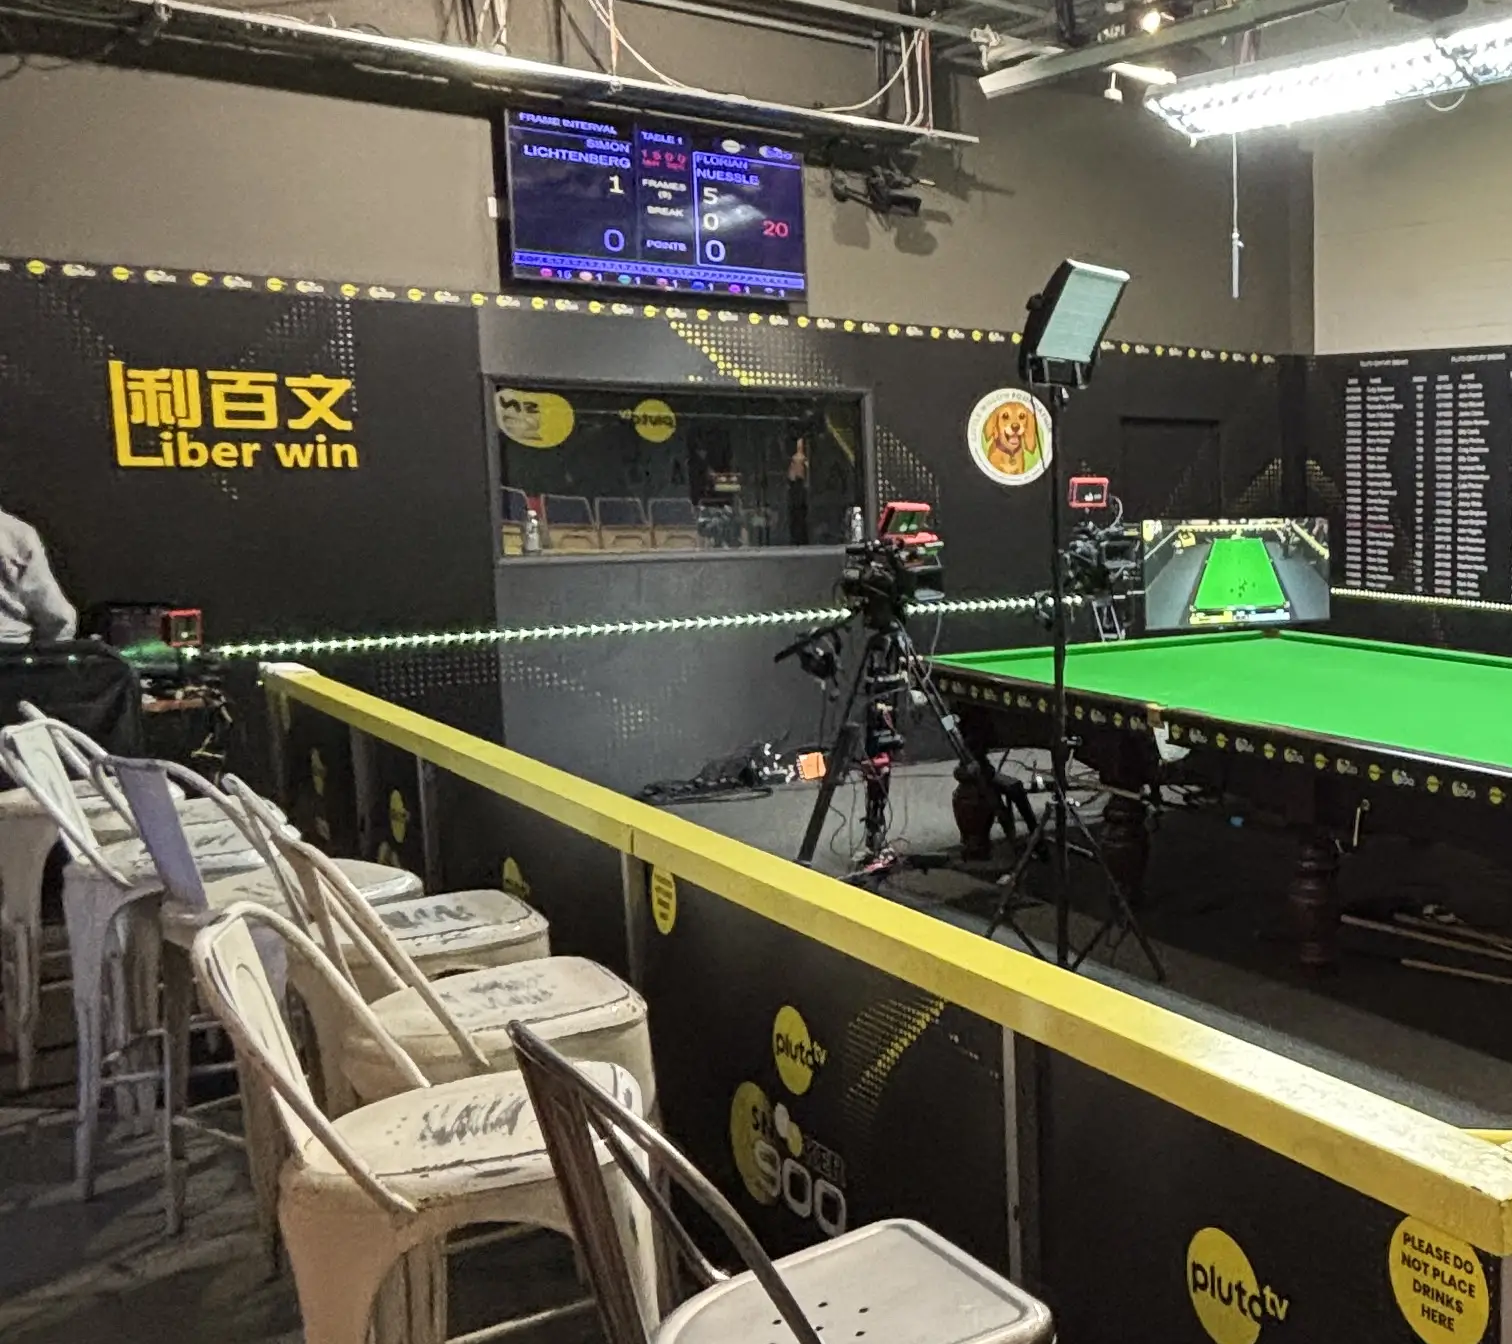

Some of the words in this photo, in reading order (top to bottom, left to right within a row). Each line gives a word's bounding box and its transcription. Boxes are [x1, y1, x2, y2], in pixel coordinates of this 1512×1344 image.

[586, 138, 630, 153] SIMON
[641, 131, 675, 144] TABLE
[523, 144, 632, 169] LICHTENBERG
[696, 154, 748, 170] FLORIAN
[609, 175, 625, 194] 1
[642, 178, 687, 192] FRAMES
[696, 168, 759, 186] NUESSLE
[703, 187, 719, 205] 5
[647, 205, 684, 217] BREAK
[703, 213, 719, 231] 0
[762, 221, 789, 238] 20
[603, 229, 625, 252] 0
[646, 239, 687, 252] POINTS
[705, 240, 726, 262] 0
[126, 368, 353, 431] 利百文
[108, 360, 261, 467] Liber
[274, 434, 359, 468] win
[754, 1140, 847, 1238] 900
[1402, 1231, 1451, 1264] PLEASE
[1452, 1254, 1474, 1274] DO
[1400, 1251, 1430, 1276] NOT
[1432, 1267, 1476, 1298] PLACE
[1412, 1278, 1464, 1314] DRINKS
[1421, 1303, 1455, 1333] HERE
